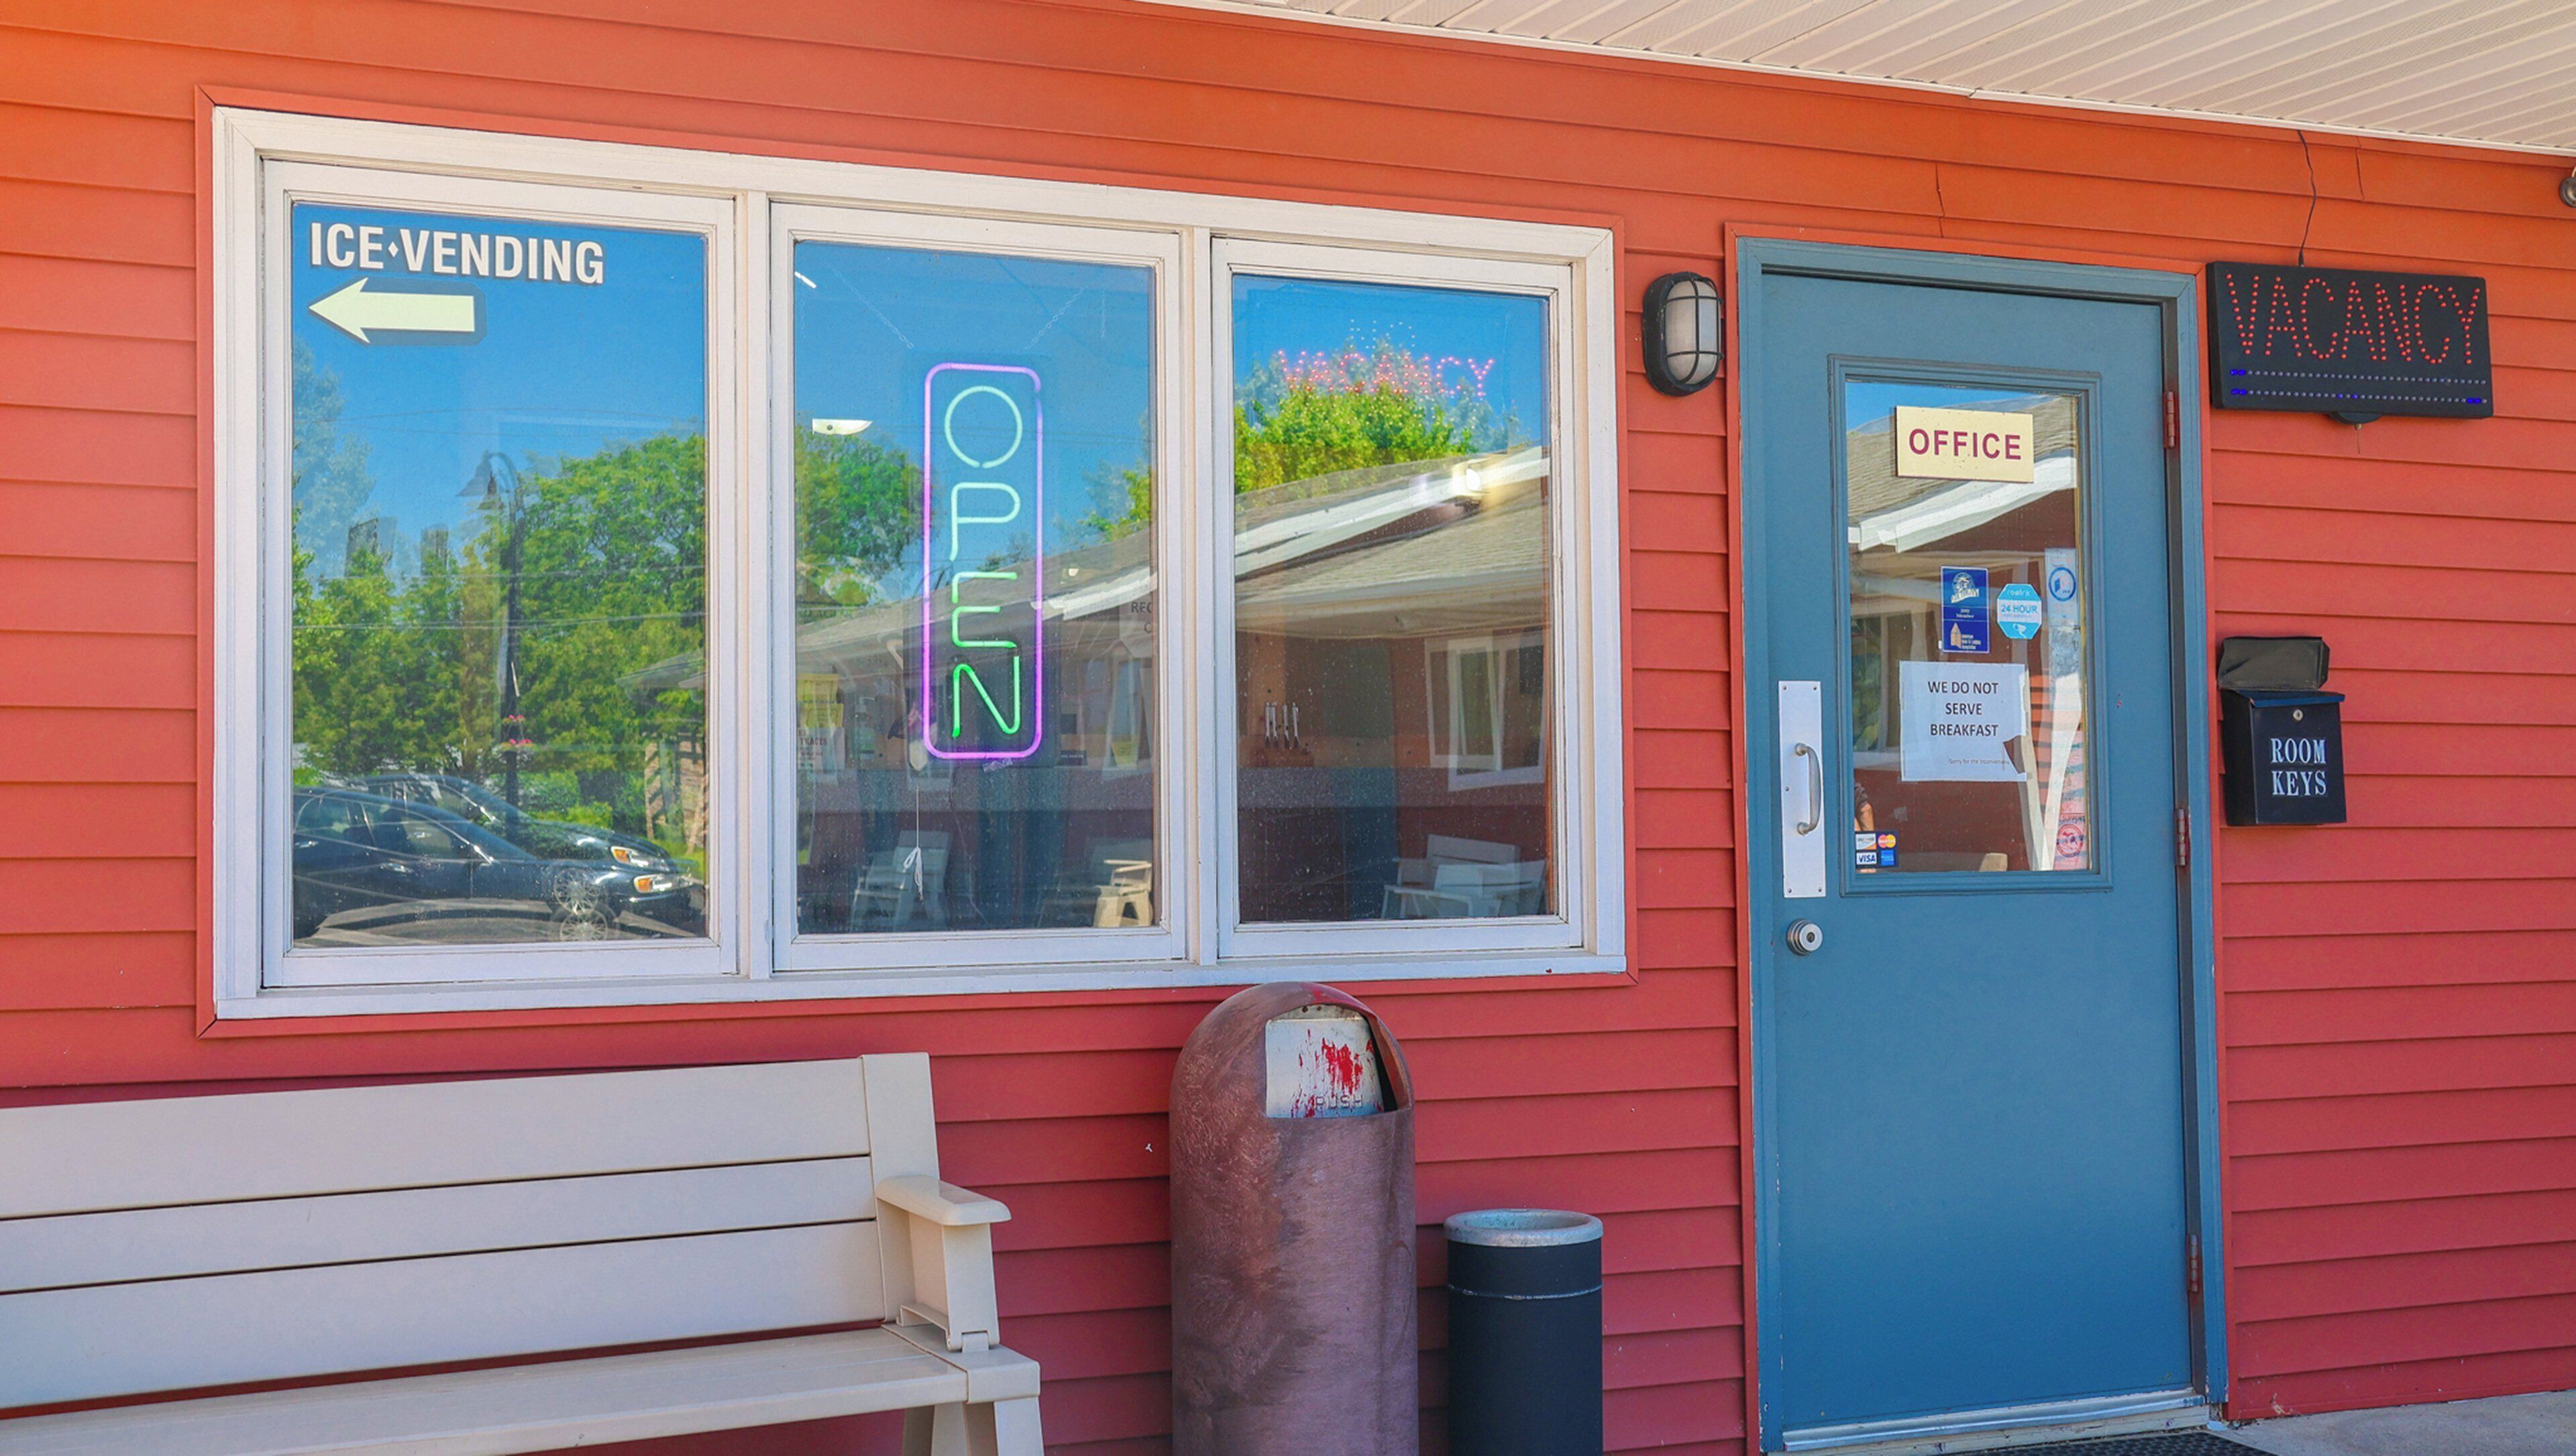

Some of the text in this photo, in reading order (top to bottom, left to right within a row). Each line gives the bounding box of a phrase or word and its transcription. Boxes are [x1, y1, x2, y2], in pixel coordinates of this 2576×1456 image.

[311, 222, 604, 284] ICE VENDING
[2225, 273, 2481, 366] VACANCY
[1277, 350, 1495, 397] VACANCY
[1909, 428, 2021, 460] OFFICE
[944, 384, 1024, 738] OPEN
[2001, 604, 2038, 614] 24 HOUR
[1927, 681, 1999, 694] WE DO NOT
[1945, 703, 1982, 715] SERVE
[1930, 724, 1999, 737] BREAKFAST
[2270, 737, 2326, 764] ROOM
[2271, 770, 2327, 797] KEYS
[1859, 854, 1876, 863] VISA
[1315, 1094, 1363, 1110] PUSH
